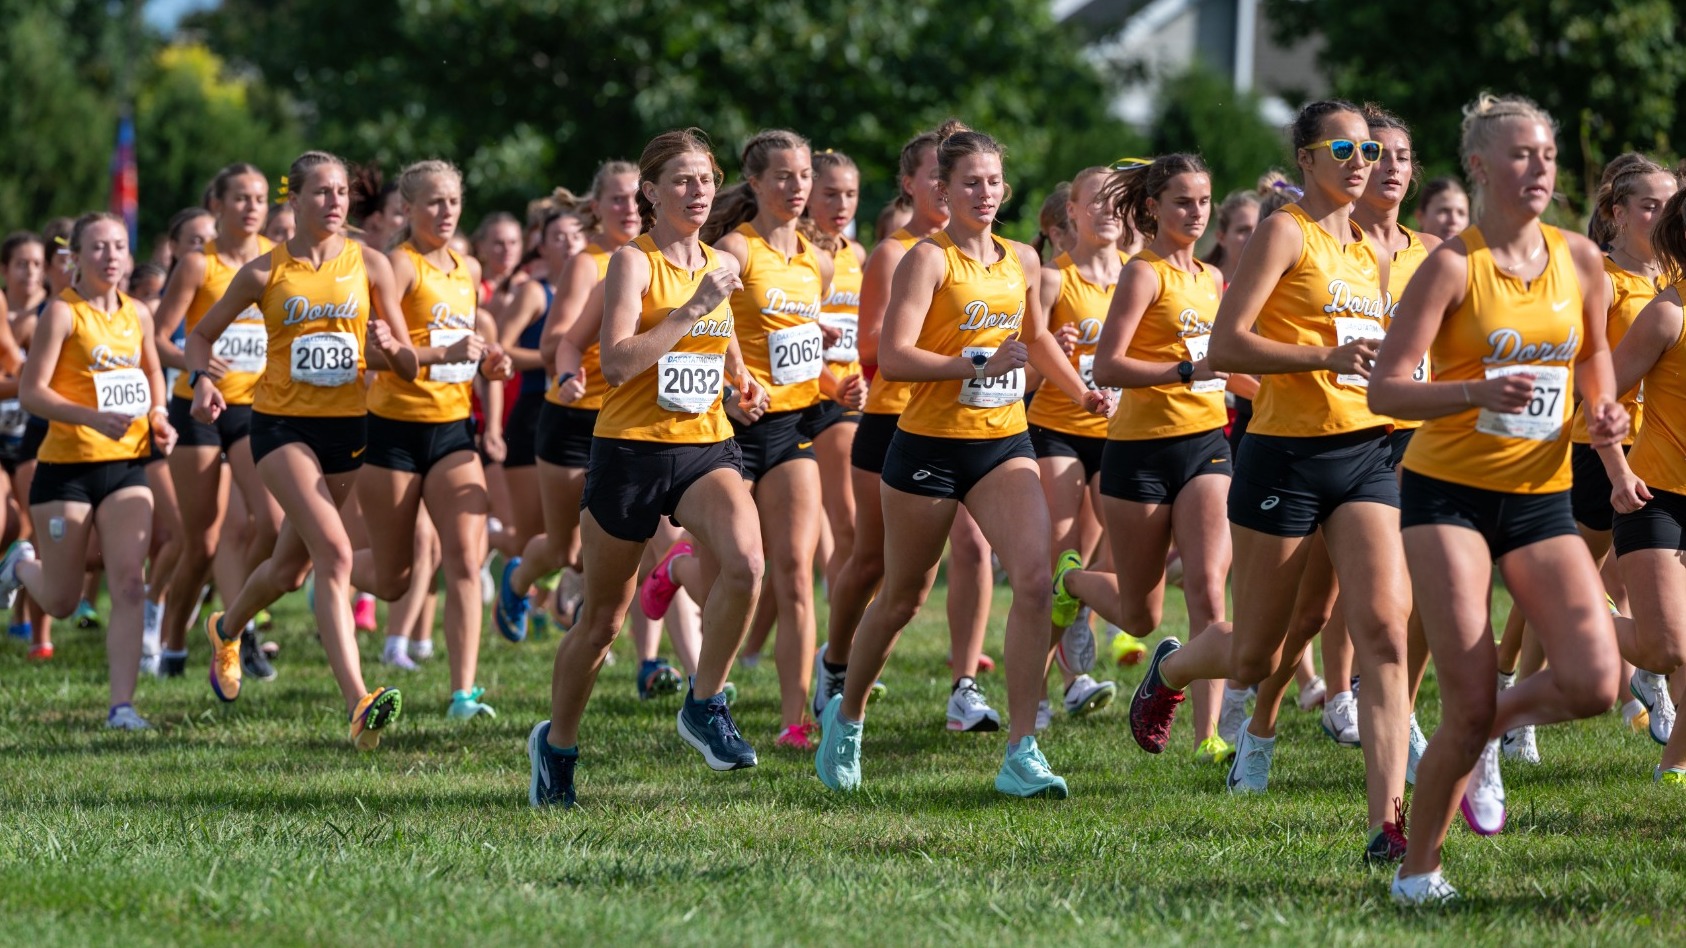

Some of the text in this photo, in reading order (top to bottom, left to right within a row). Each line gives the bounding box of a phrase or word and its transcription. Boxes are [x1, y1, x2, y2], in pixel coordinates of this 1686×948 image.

[283, 292, 358, 326] Dordt
[218, 336, 265, 358] 2046
[296, 346, 354, 370] 2038
[774, 336, 821, 369] 2062
[1482, 326, 1579, 364] Dordt
[102, 383, 147, 407] 2065
[664, 367, 720, 395] 2032
[1528, 386, 1561, 418] 67
